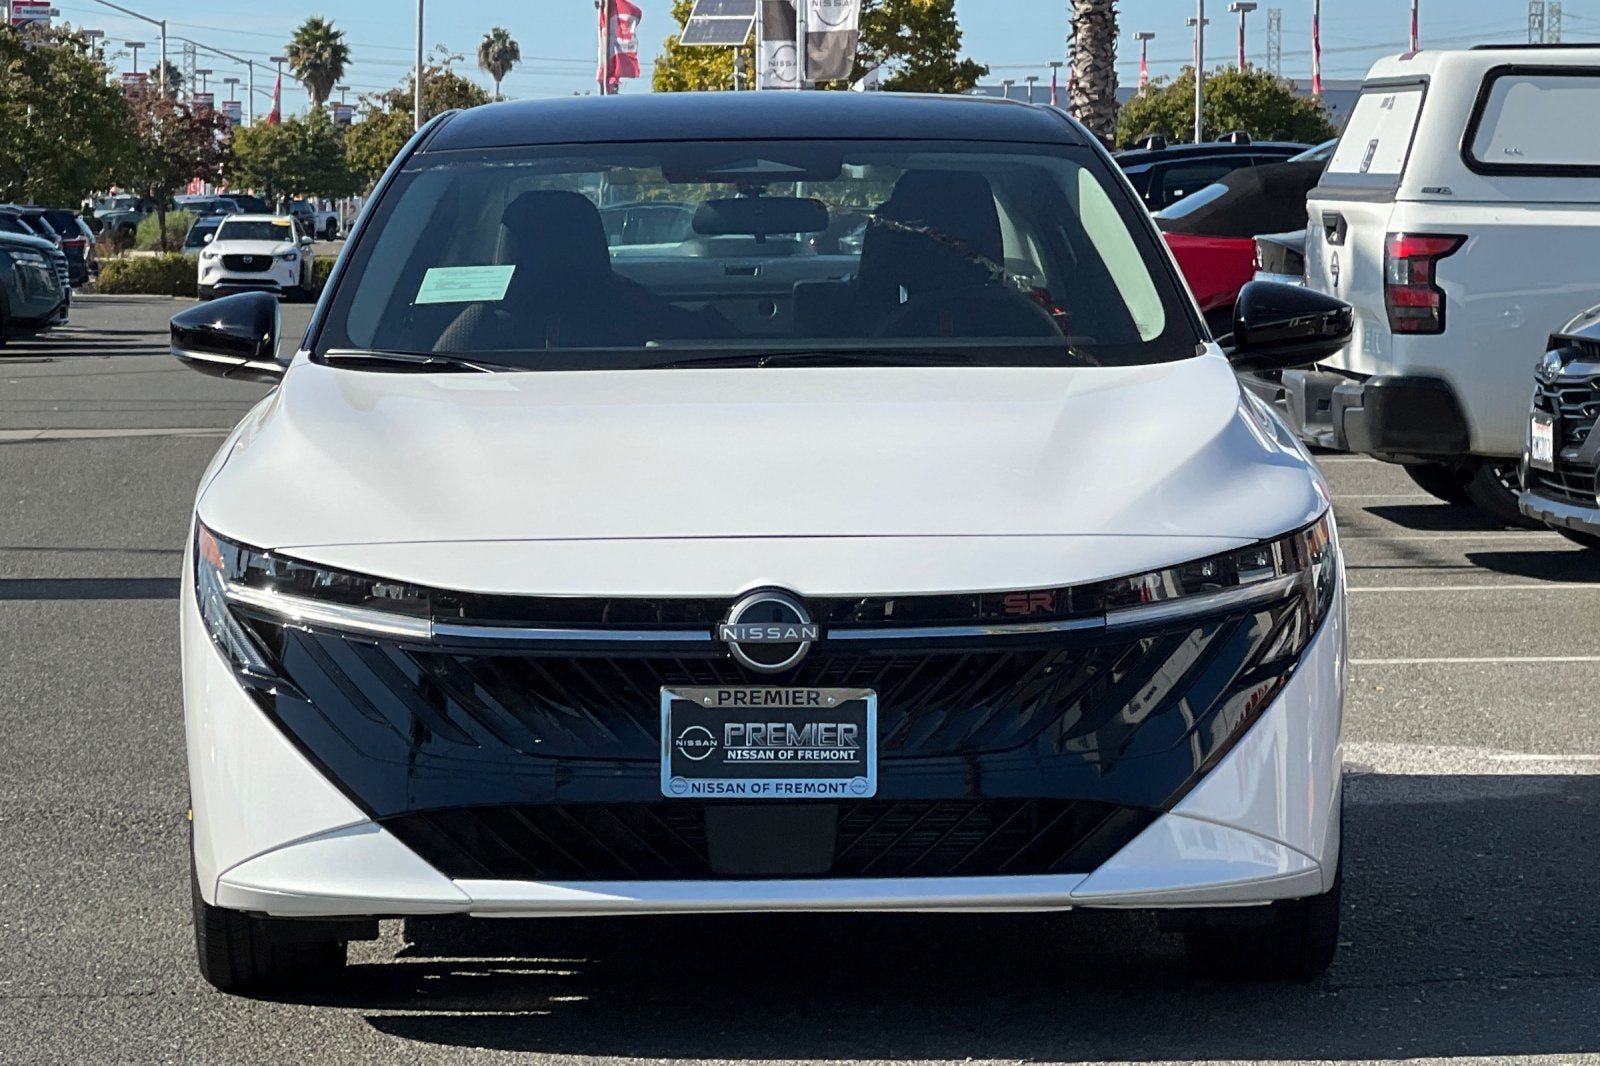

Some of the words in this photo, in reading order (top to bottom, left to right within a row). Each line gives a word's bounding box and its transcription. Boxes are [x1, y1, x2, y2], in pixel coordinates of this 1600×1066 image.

[1004, 593, 1055, 614] SR
[723, 627, 816, 640] NISSAN
[717, 690, 820, 706] PREMIER
[724, 722, 859, 747] PREMIER
[727, 750, 774, 760] NISSAN
[778, 750, 795, 760] OF
[798, 750, 856, 760] FREMONT
[691, 783, 746, 794] NISSAN
[750, 783, 770, 794] OF
[775, 783, 847, 794] FREMONT
